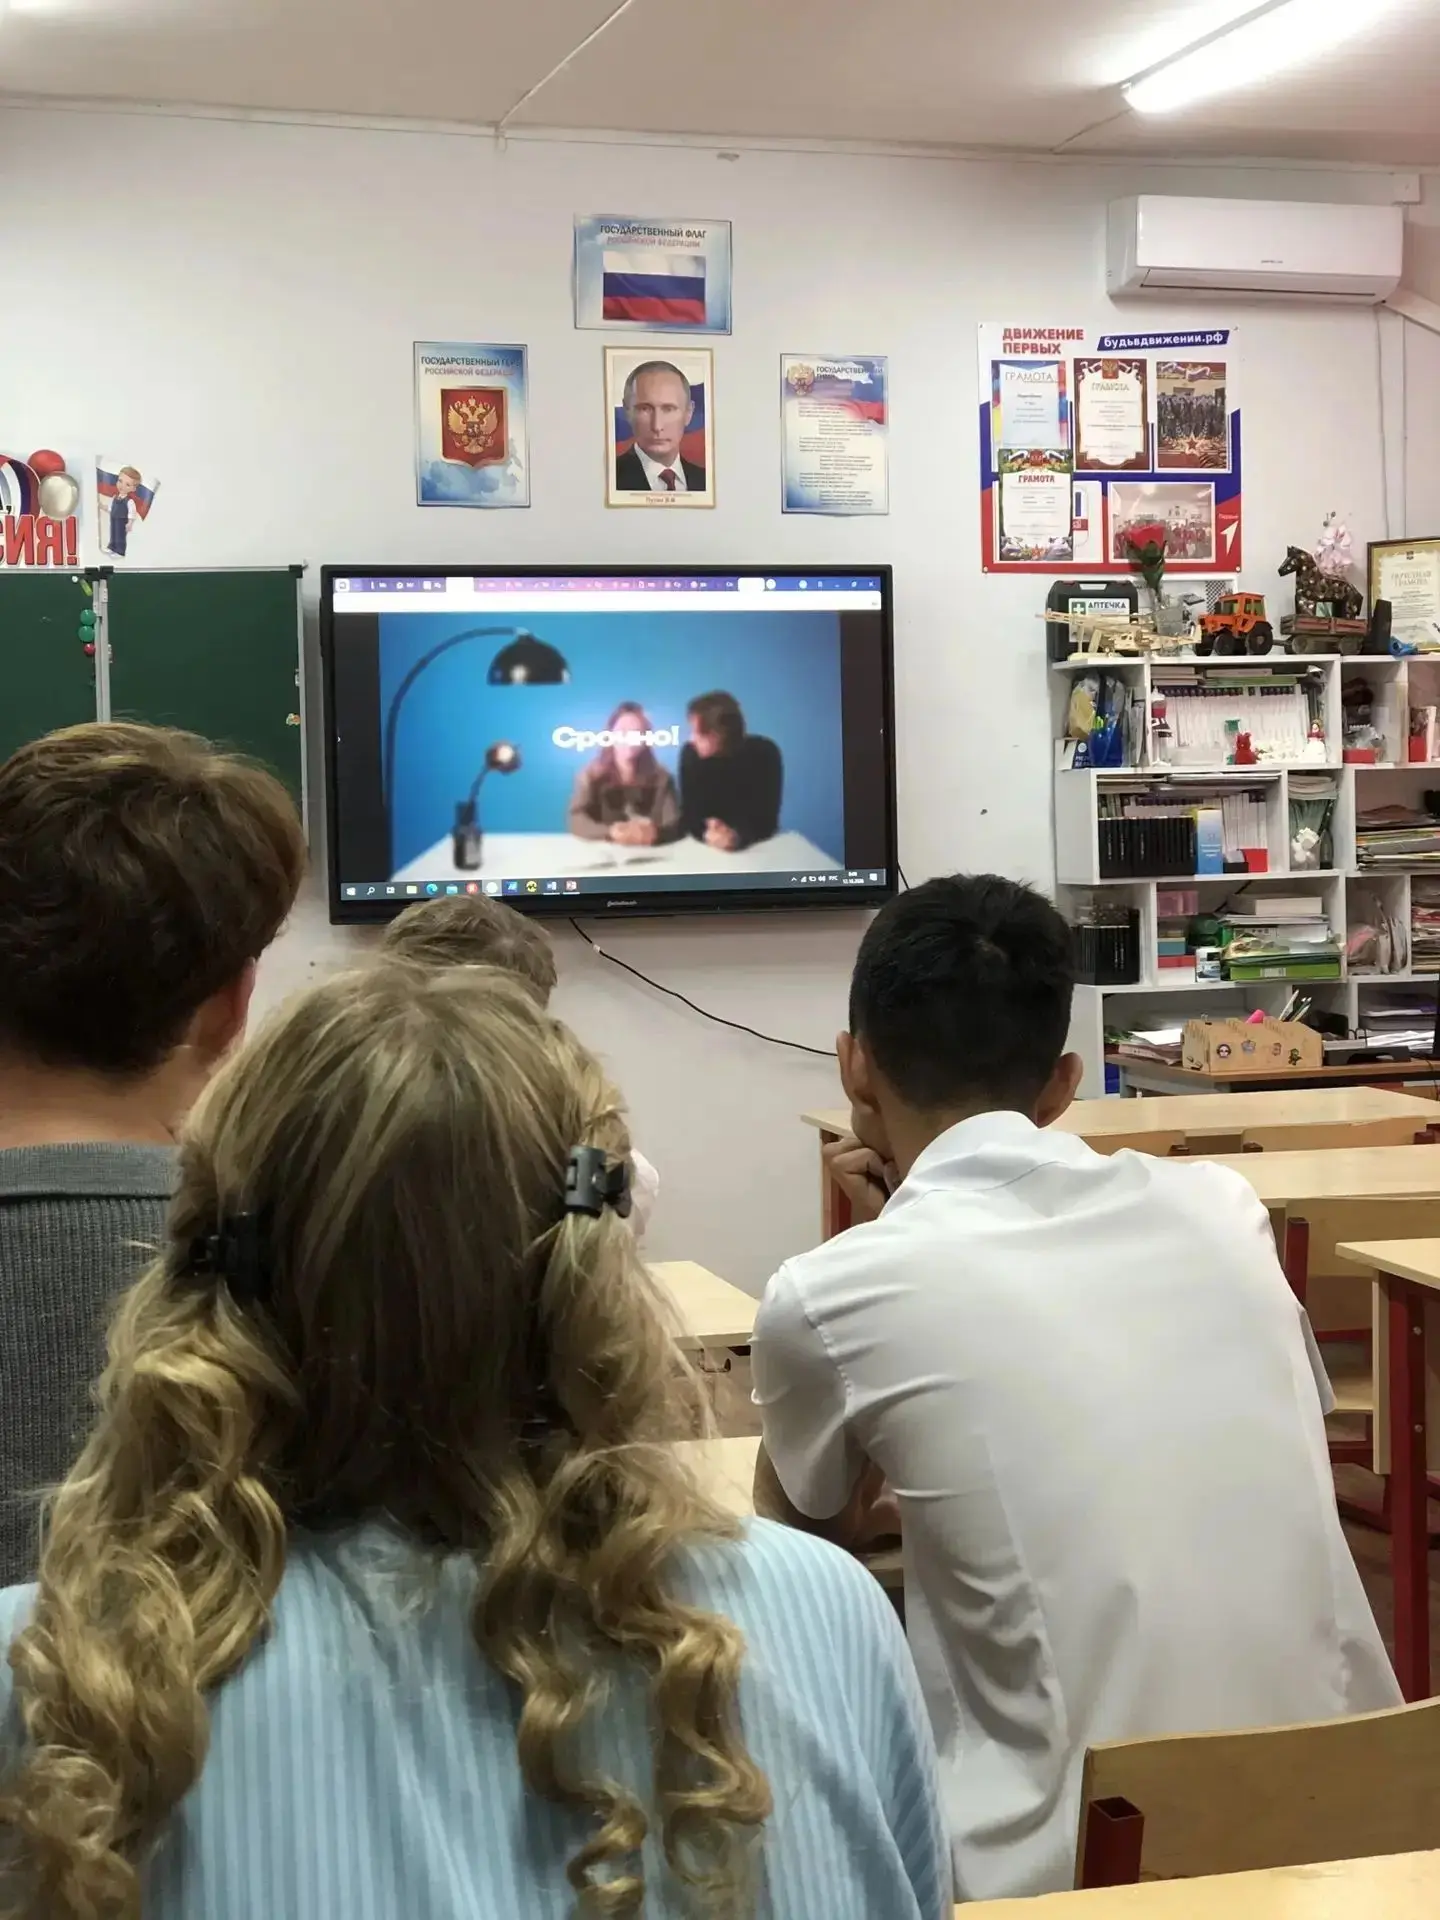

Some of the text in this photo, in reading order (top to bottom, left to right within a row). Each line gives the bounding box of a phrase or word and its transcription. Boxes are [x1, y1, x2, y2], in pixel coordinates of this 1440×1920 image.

[600, 225, 706, 239] ГОСУДАРСТВЕННЫЙ ФЛАГ
[1002, 328, 1084, 341] ДВИЖЕНИЕ
[1104, 331, 1224, 348] будьвдвижении.рф
[1002, 342, 1062, 355] ПЕРВЫХ
[420, 356, 500, 366] ГОСУДАРСТВЕННЫЙ
[1005, 371, 1053, 381] ГРАМОТА
[1018, 475, 1055, 483] ГРАМОТА
[0, 515, 78, 566] ИЯ!
